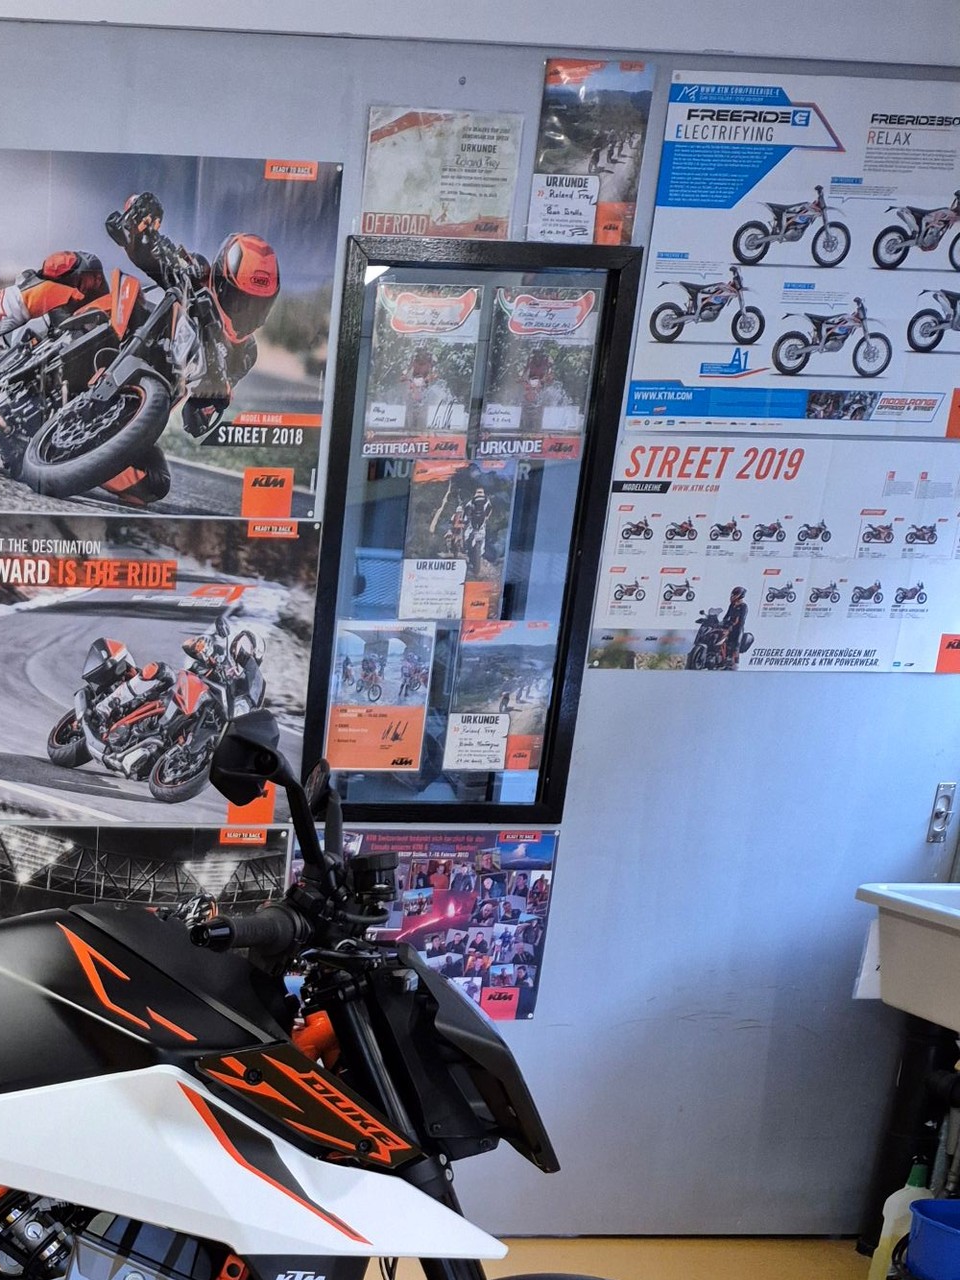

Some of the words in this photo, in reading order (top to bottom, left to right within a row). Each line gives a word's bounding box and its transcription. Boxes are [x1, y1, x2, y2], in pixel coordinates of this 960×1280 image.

[687, 109, 791, 124] FREERIDE
[676, 124, 774, 141] ELECTRIFYING
[867, 131, 912, 145] RELAX
[461, 143, 498, 154] URKUNDE
[546, 176, 589, 188] URKUNDE
[365, 214, 428, 235] OFFROAD
[731, 347, 749, 370] A1
[633, 391, 693, 400] WWW.KTM.COM
[240, 414, 261, 423] MODEL
[218, 426, 268, 444] STREET
[272, 428, 303, 445] 2018
[363, 442, 429, 455] CERTIFICATE
[480, 440, 542, 455] URKUNDE
[625, 445, 735, 479] STREET
[736, 447, 805, 480] 2019
[251, 475, 286, 488] KTM
[622, 483, 662, 492] MODELLREIHE
[672, 484, 720, 492] WWW.KTM.COM
[8, 538, 28, 553] THE
[32, 539, 101, 555] DESTINATION
[416, 561, 456, 571] URKUNDE
[58, 560, 77, 585] IS
[83, 560, 120, 587] THE
[127, 561, 175, 588] RIDE
[752, 648, 784, 657] STEIGERE
[786, 649, 802, 657] DEIN
[803, 647, 862, 658] FAHRVERGNÜGEN
[863, 649, 877, 657] MIT
[748, 657, 764, 666] KTM
[765, 657, 809, 666] POWERPARTS
[811, 658, 816, 666] &
[819, 658, 833, 666] KTM
[461, 715, 500, 725] URKUNDE
[391, 758, 413, 766] KTM
[487, 991, 513, 1001] KTM
[300, 1075, 400, 1148] DUKE
